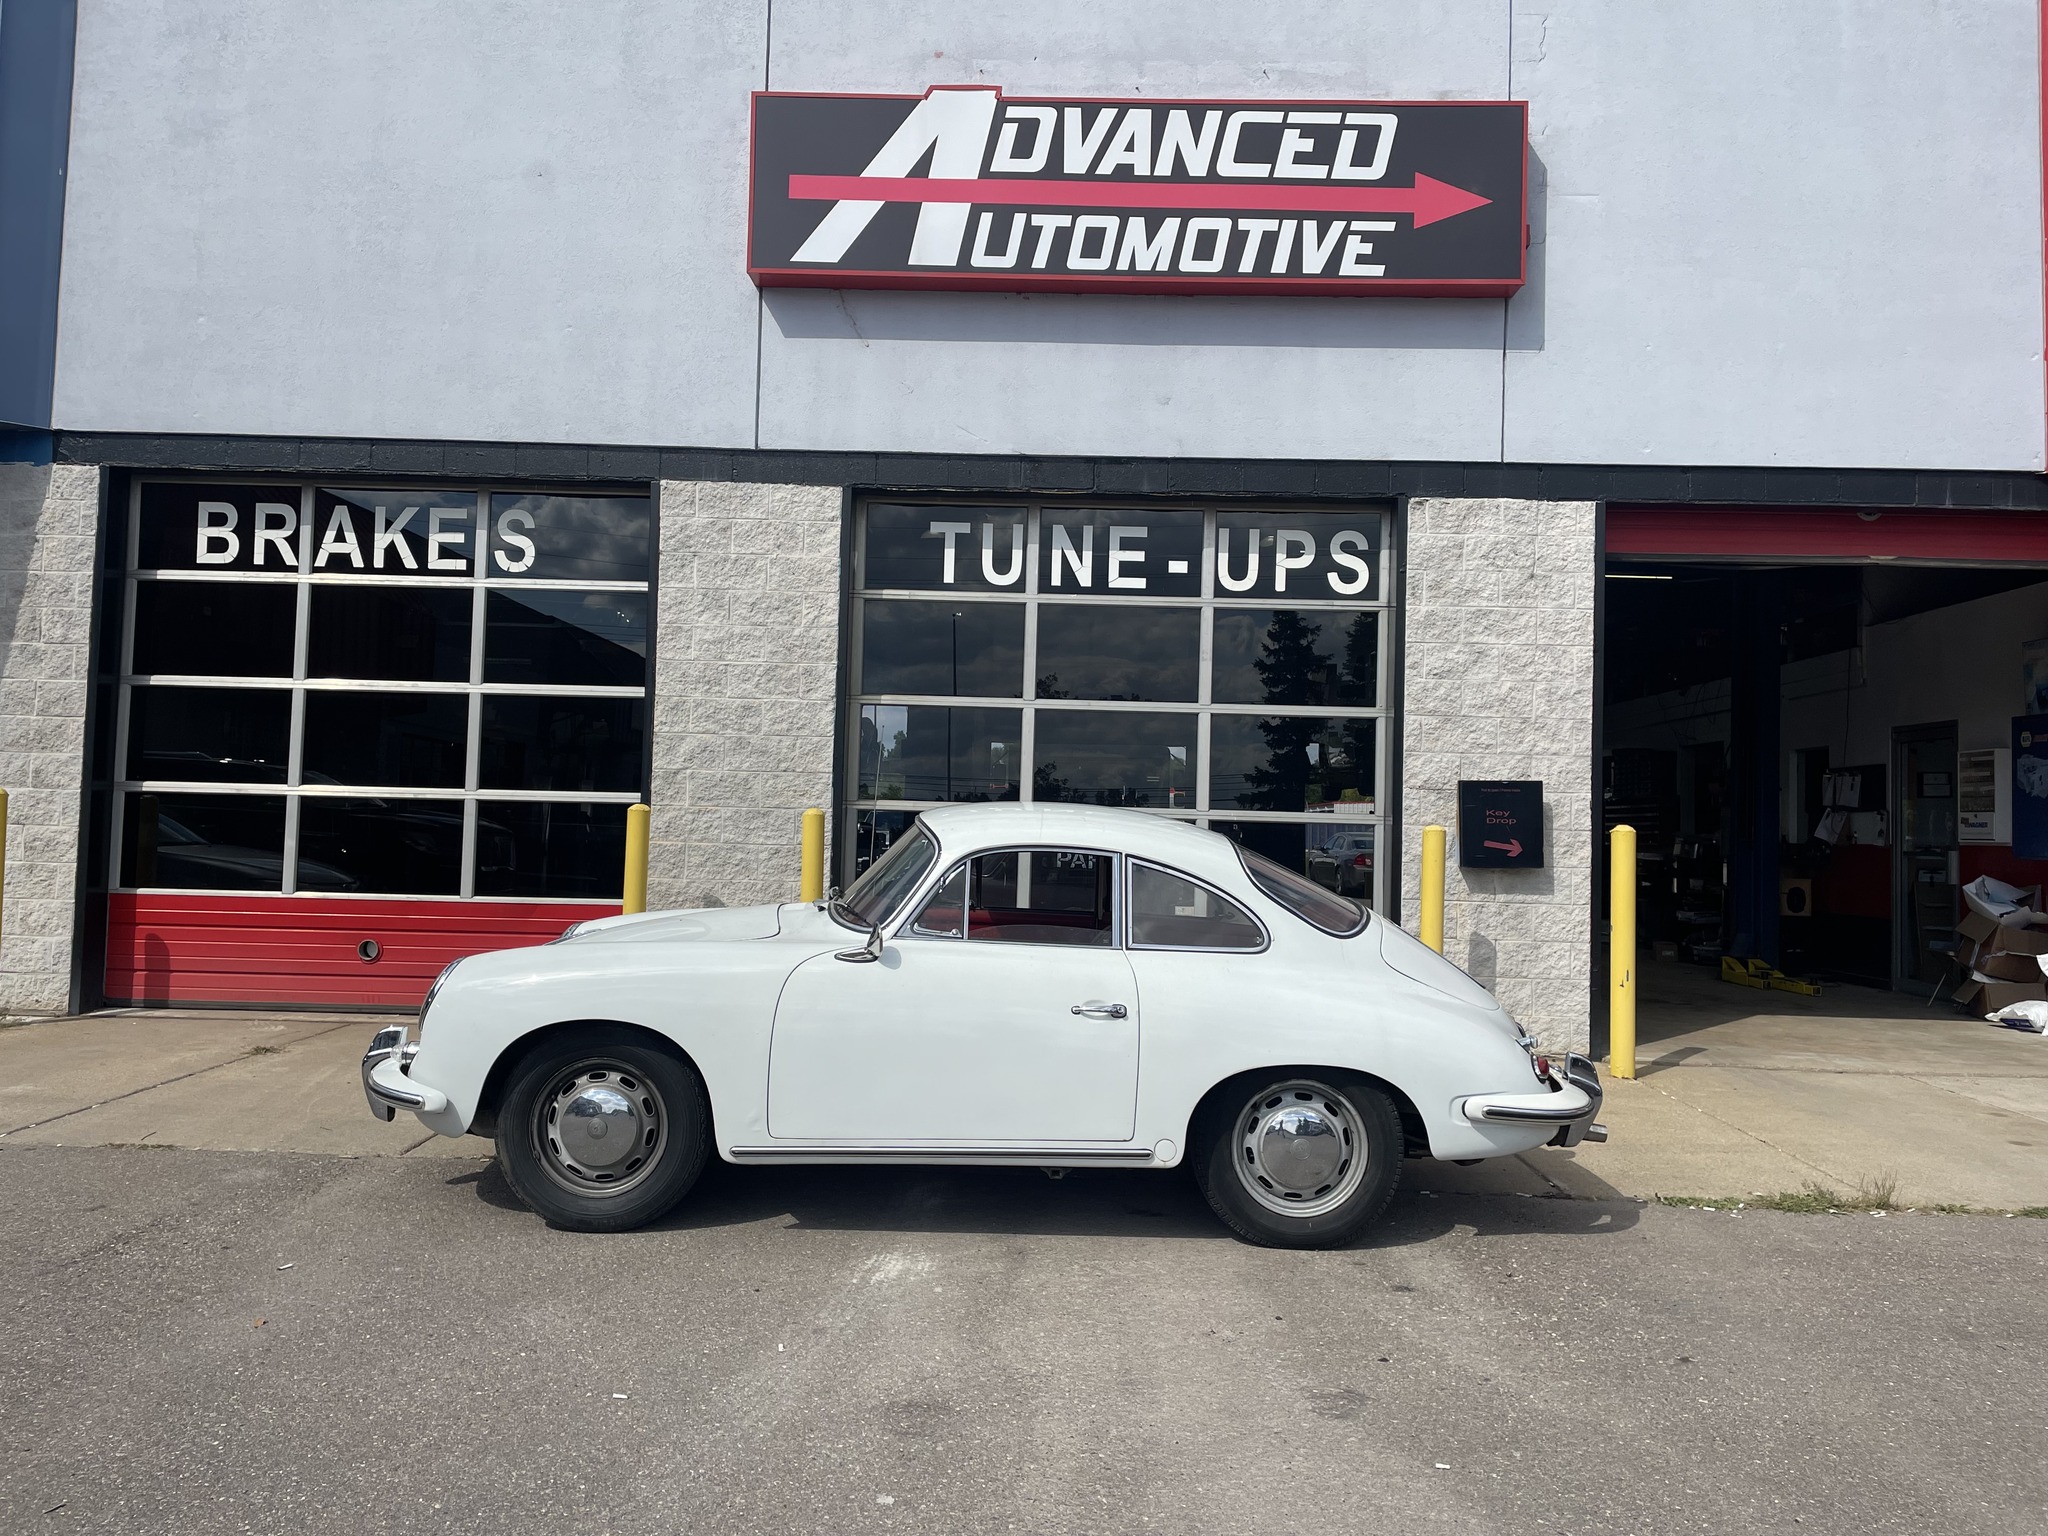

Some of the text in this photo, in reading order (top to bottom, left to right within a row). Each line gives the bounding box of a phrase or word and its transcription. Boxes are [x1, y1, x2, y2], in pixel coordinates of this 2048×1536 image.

[859, 89, 1399, 181] ADVANCED
[790, 199, 1397, 277] AUTOMOTIVE
[196, 500, 537, 573] BRAKES
[930, 520, 1370, 595] TUNE-UPS
[1486, 809, 1511, 817] Key
[1486, 817, 1517, 825] Drop
